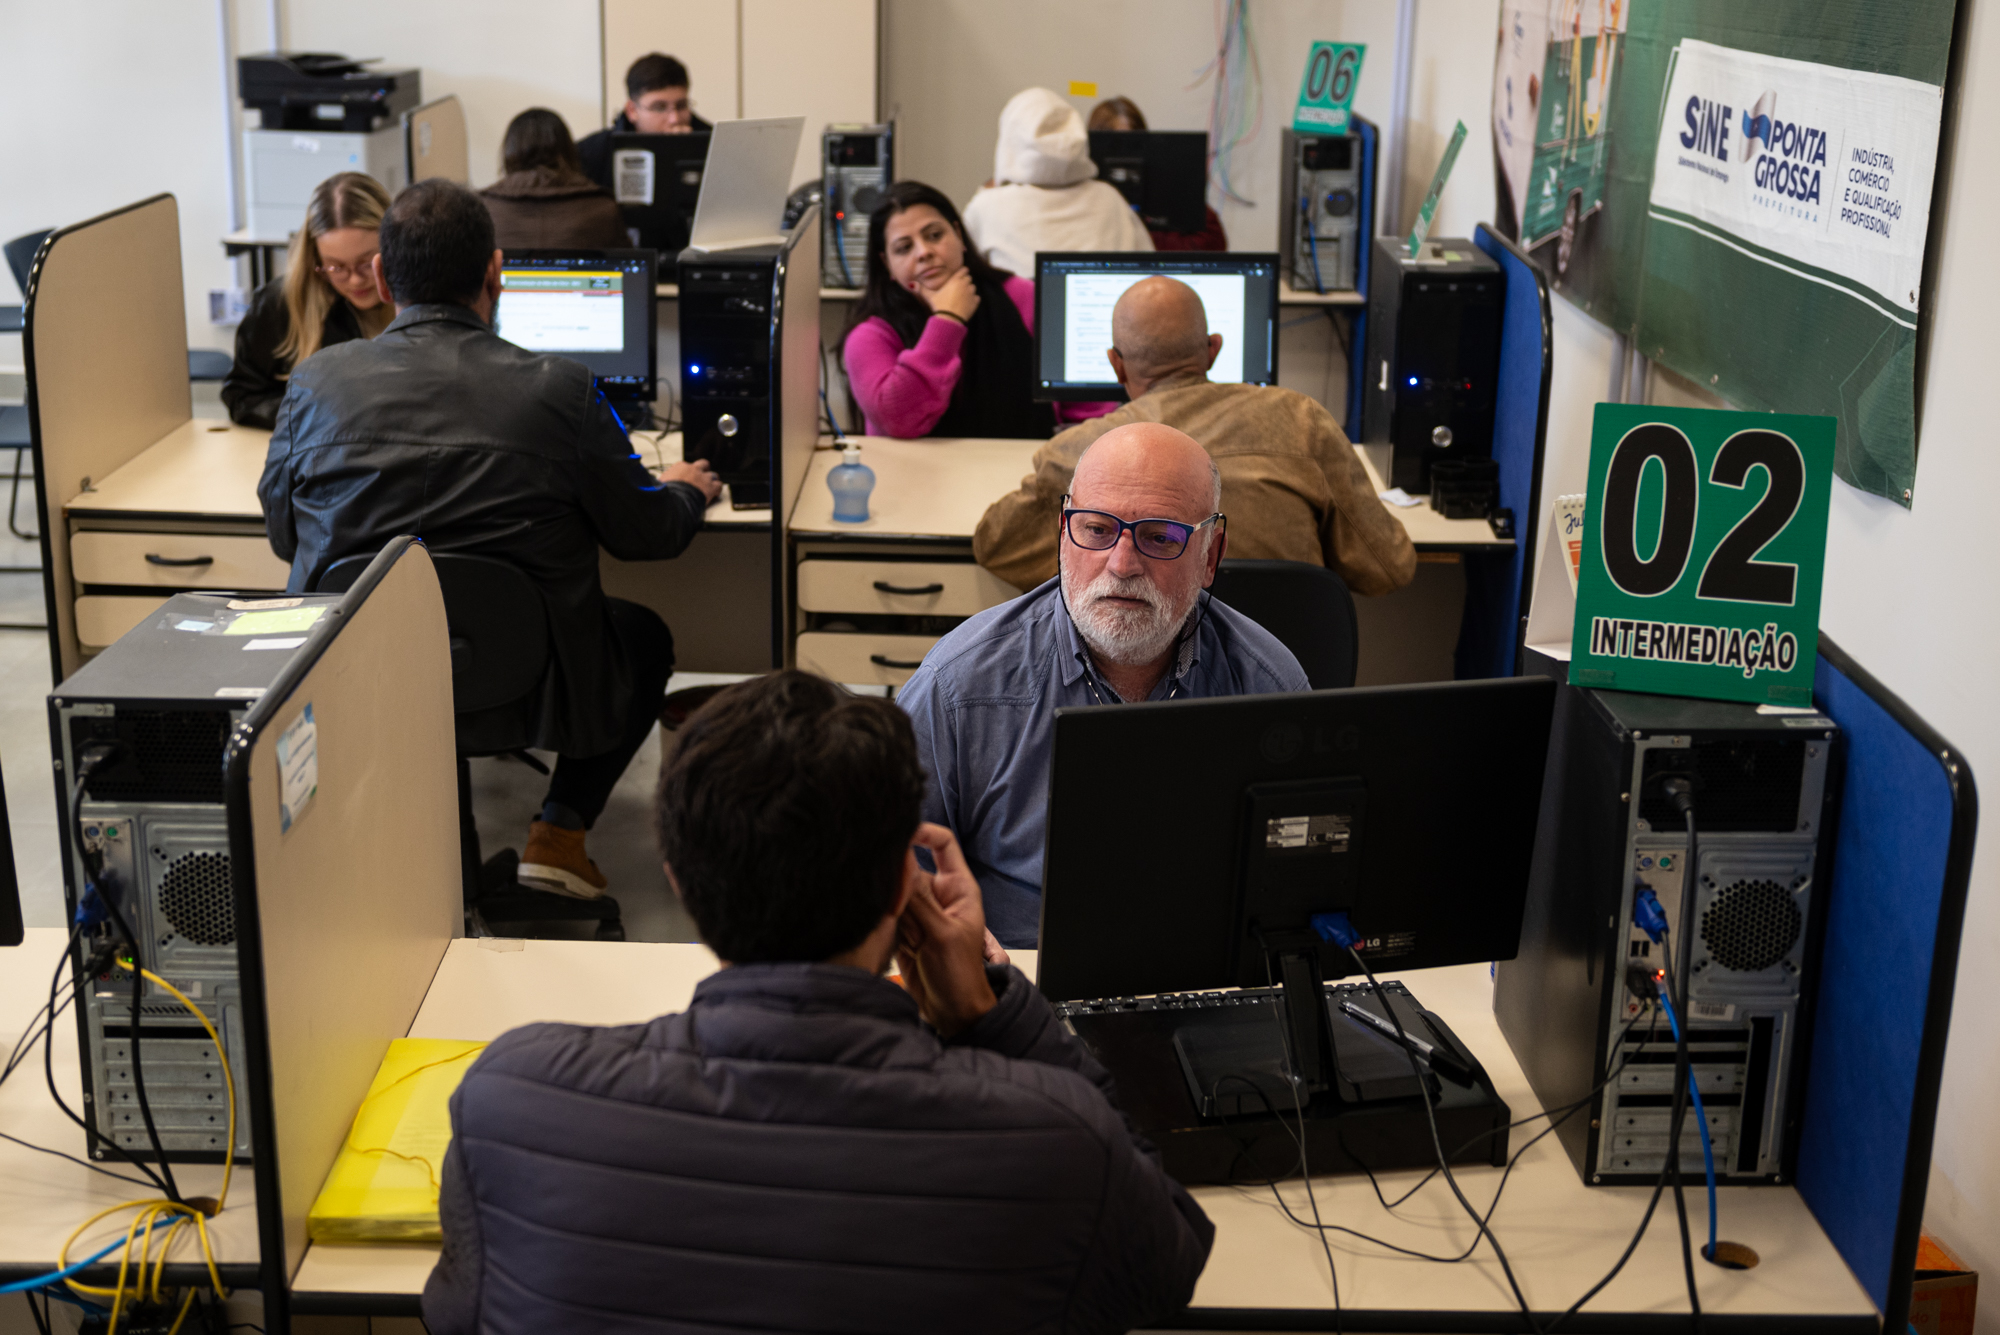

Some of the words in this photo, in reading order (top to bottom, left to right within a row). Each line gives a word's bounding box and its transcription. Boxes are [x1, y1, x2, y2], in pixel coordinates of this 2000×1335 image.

[1306, 46, 1358, 102] 06
[1769, 120, 1827, 167] PONTA
[1852, 147, 1895, 175] INDÚSTRIA,
[1755, 154, 1821, 205] GROSSA
[1849, 168, 1890, 192] COMÉRCIO
[1752, 193, 1818, 223] PREFEITURA
[1844, 188, 1851, 202] E
[1852, 189, 1902, 221] QUALIFICAÇÃO
[1841, 207, 1892, 239] PROFISSIONAL
[1600, 422, 1806, 606] 02
[1589, 616, 1799, 679] INTERMEDIAÇÃO
[1366, 938, 1381, 948] LG
